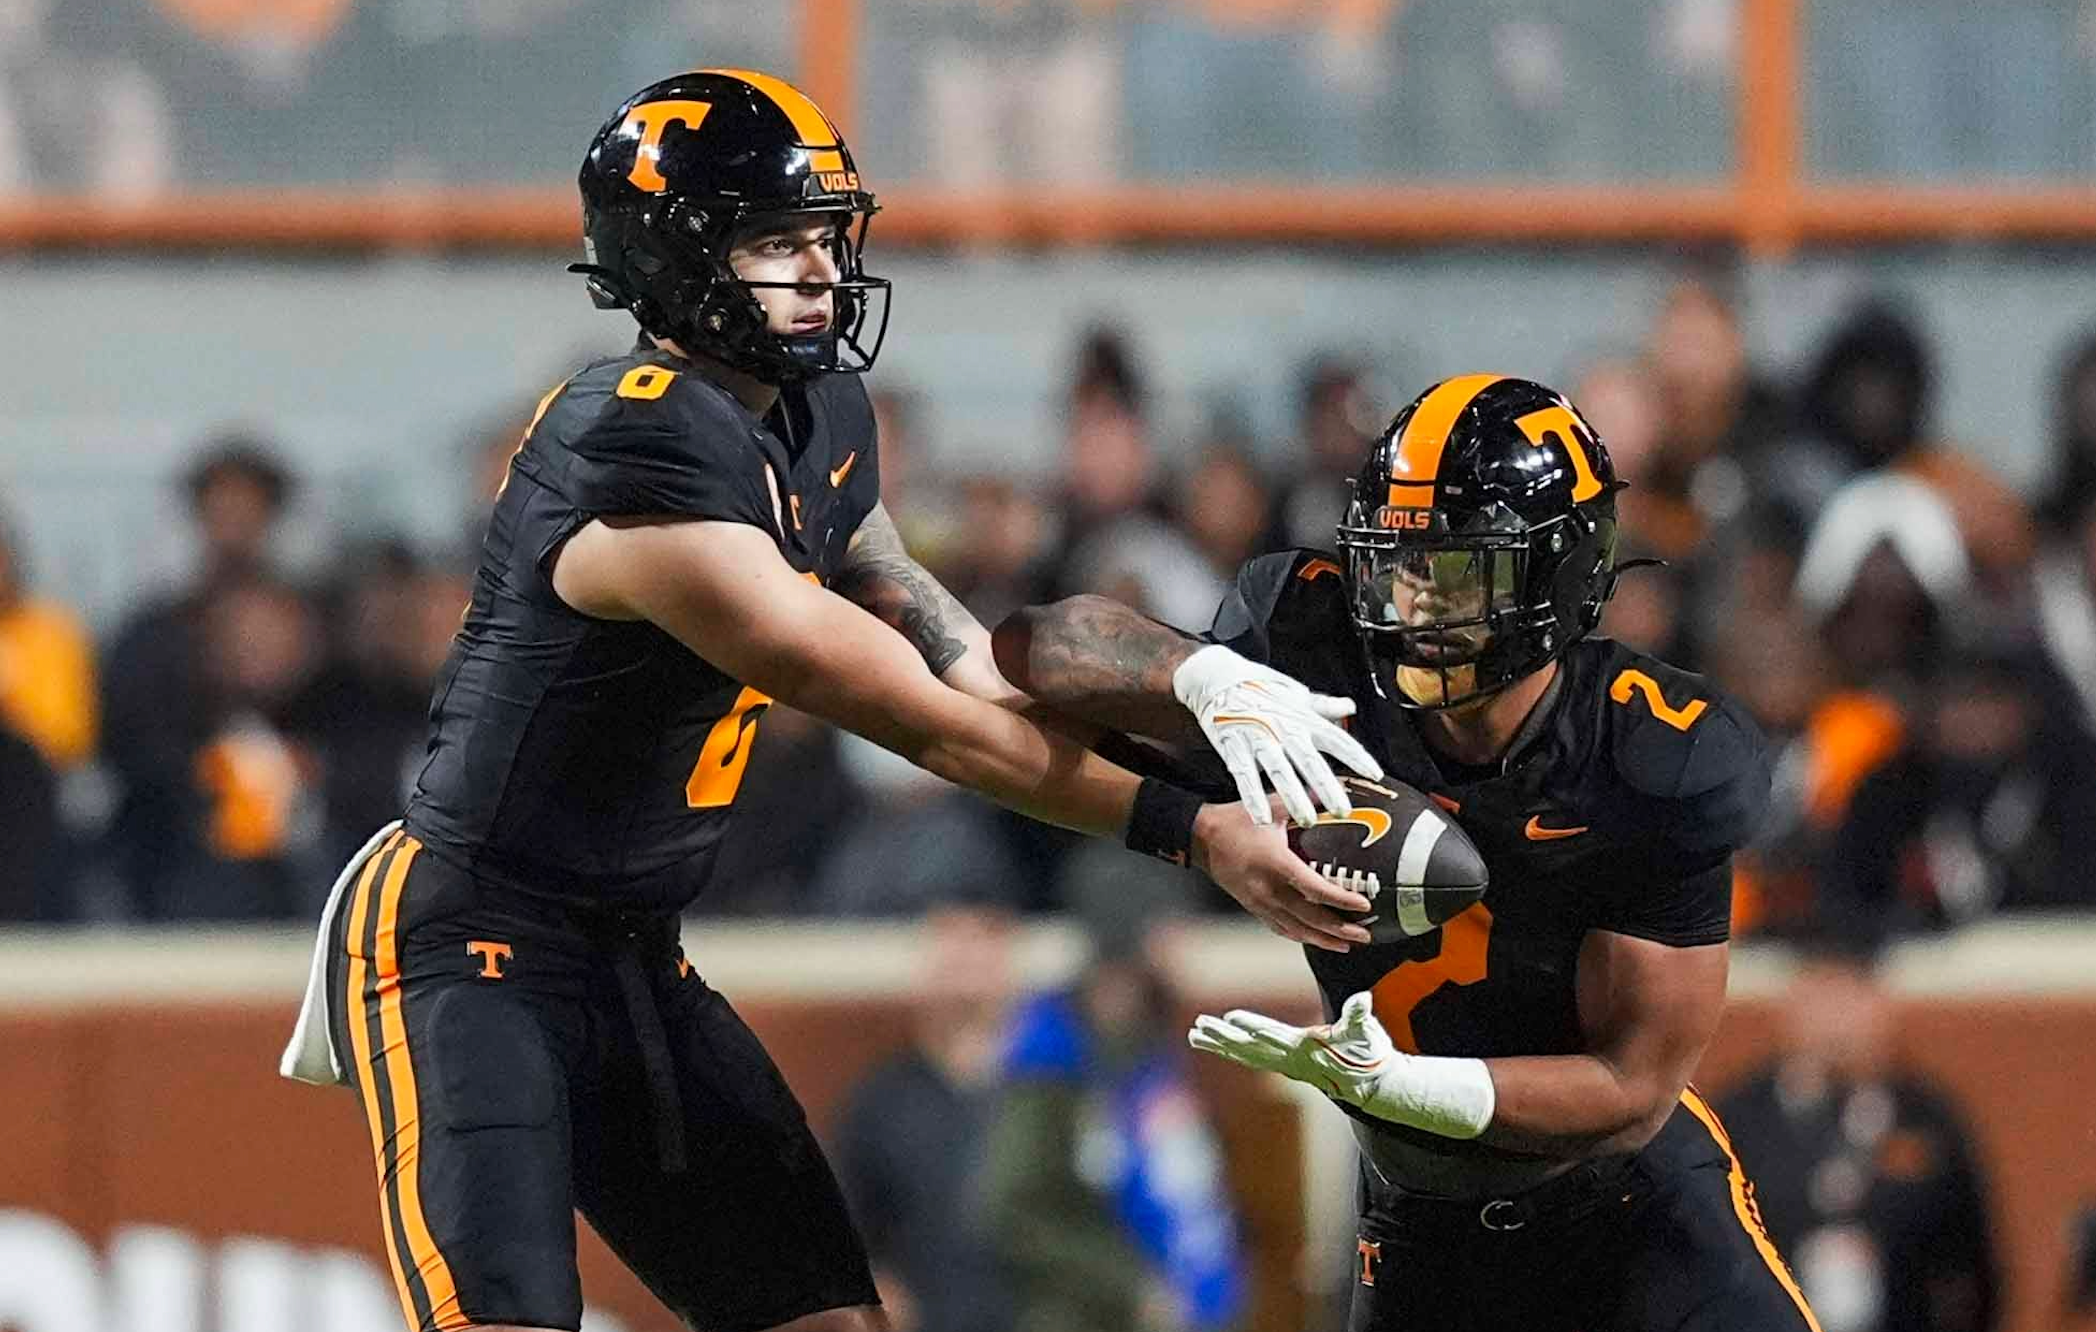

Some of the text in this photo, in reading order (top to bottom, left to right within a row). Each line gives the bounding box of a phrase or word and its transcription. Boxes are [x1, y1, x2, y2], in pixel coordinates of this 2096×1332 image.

[618, 100, 712, 192] T
[819, 172, 858, 192] VOLS
[1513, 406, 1603, 503] T
[1380, 510, 1430, 529] VOLS
[1610, 670, 1708, 732] 2
[466, 941, 514, 978] T
[1356, 1234, 1382, 1287] T
